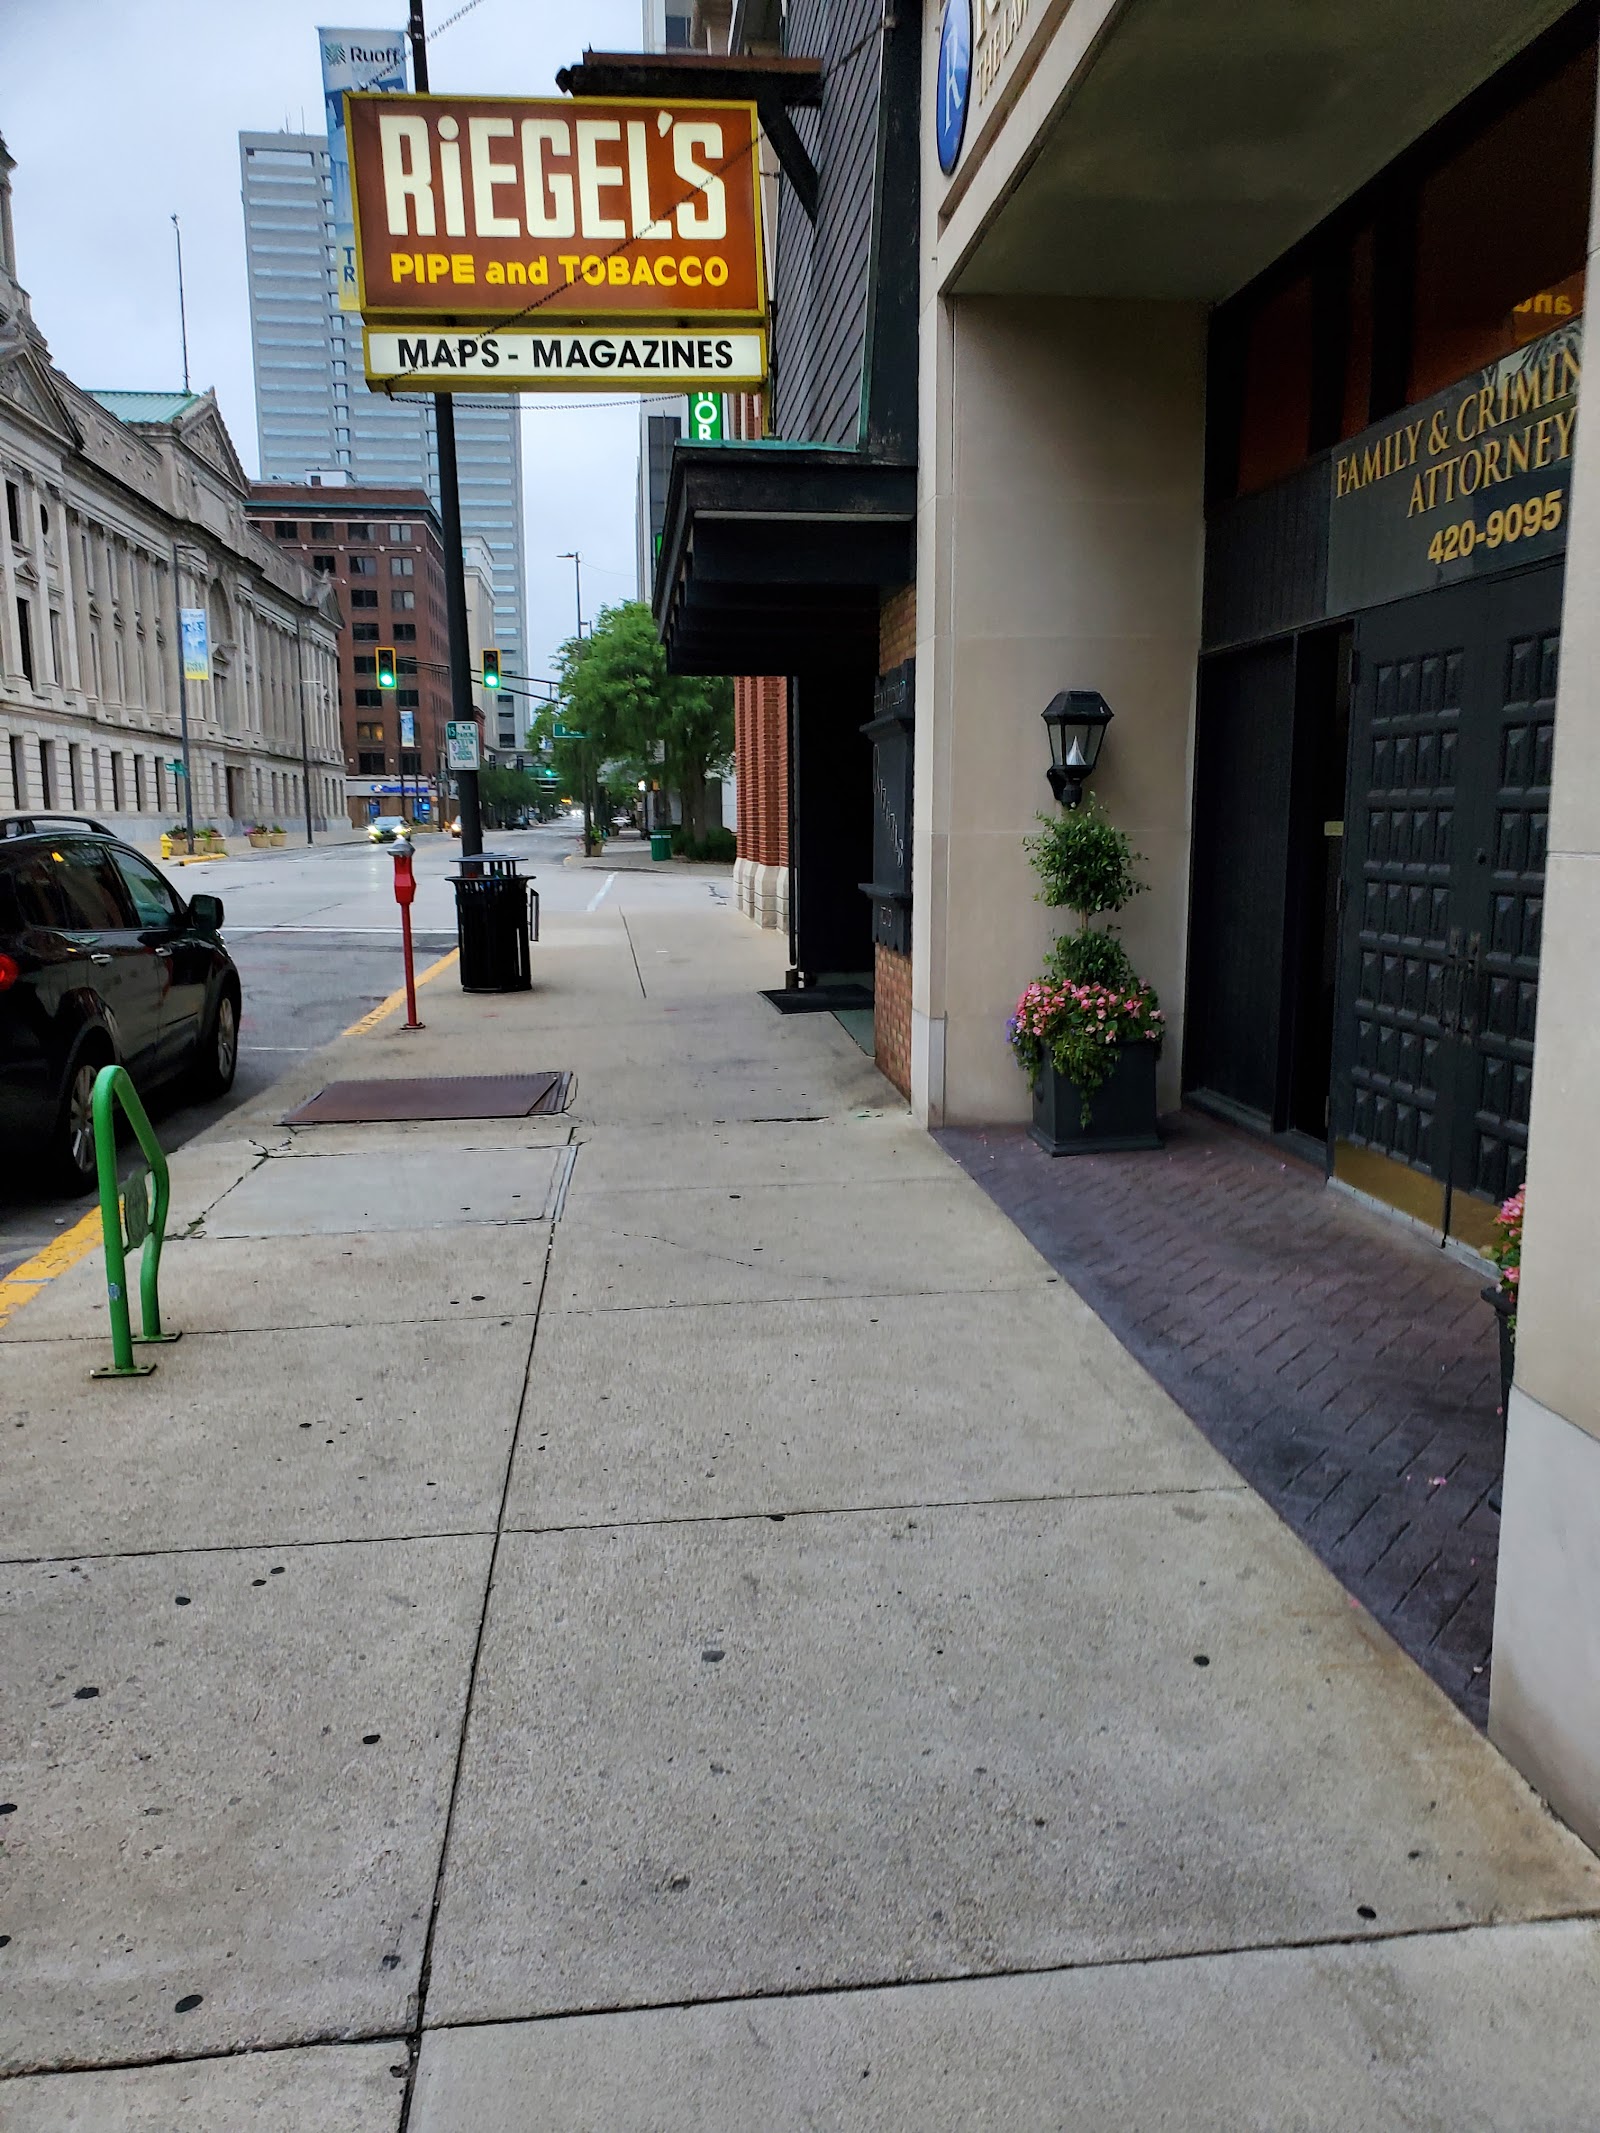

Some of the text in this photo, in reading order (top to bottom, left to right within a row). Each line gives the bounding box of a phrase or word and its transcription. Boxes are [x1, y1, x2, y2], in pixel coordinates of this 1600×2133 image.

[390, 253, 729, 287] PIPE and TOBACCO
[397, 338, 500, 368] MAPS
[532, 339, 733, 369] MAGAZINES
[1336, 418, 1425, 499] FAMILY
[1427, 408, 1450, 456] &
[1427, 489, 1563, 565] 420-9095
